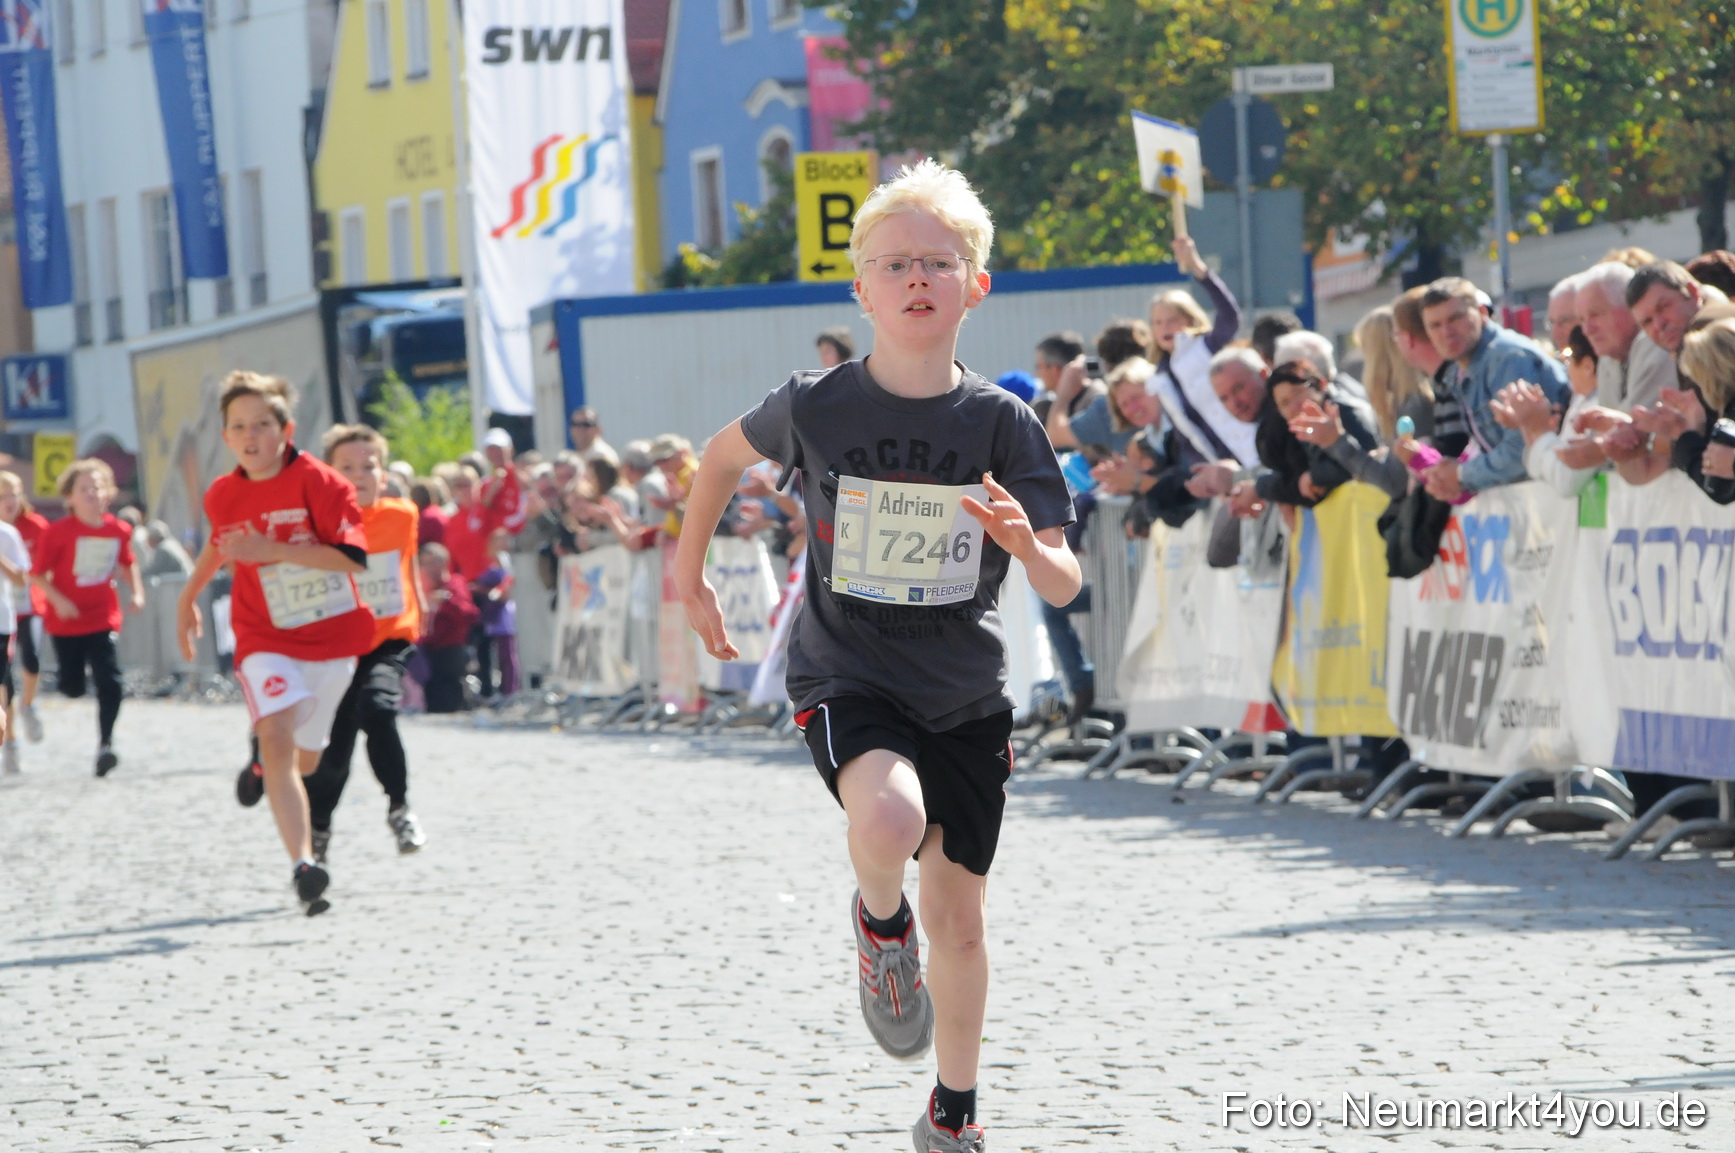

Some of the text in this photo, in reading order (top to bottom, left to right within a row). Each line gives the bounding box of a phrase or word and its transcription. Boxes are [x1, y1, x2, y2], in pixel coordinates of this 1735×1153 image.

[482, 27, 611, 64] swn
[804, 157, 869, 183] Block
[819, 192, 857, 250] B
[878, 490, 944, 518] Adrian
[840, 521, 850, 540] K
[878, 529, 972, 565] 7246
[288, 573, 343, 602] 7233
[847, 581, 886, 596] BOCK
[926, 582, 975, 597] PFLEIDERER
